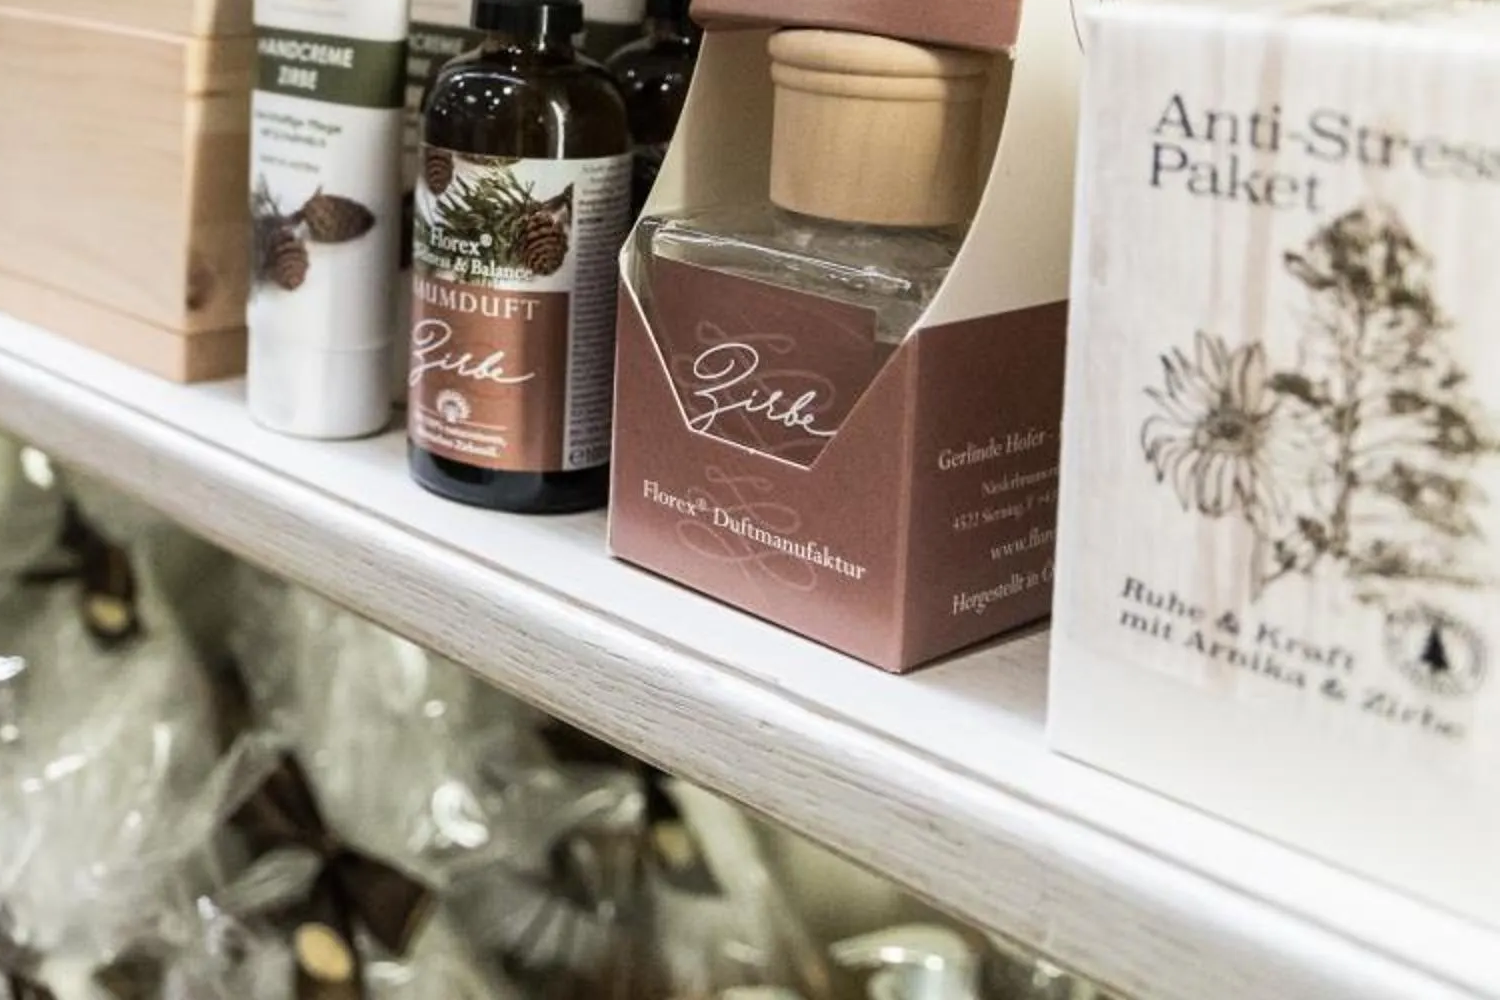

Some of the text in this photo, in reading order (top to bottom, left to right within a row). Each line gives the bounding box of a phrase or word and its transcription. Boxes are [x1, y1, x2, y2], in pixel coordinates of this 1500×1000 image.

[1149, 141, 1320, 213] Paket
[471, 259, 533, 281] Balance
[408, 318, 535, 388] Zirbe
[689, 342, 839, 436] Zirbe
[713, 506, 867, 580] Duftmanufaktur
[1119, 608, 1173, 641] mit
[1183, 630, 1307, 690] Arnika
[1320, 677, 1348, 702] &
[1120, 576, 1206, 621] Ruhe
[1215, 610, 1241, 636] &
[1255, 621, 1355, 671] Kraft
